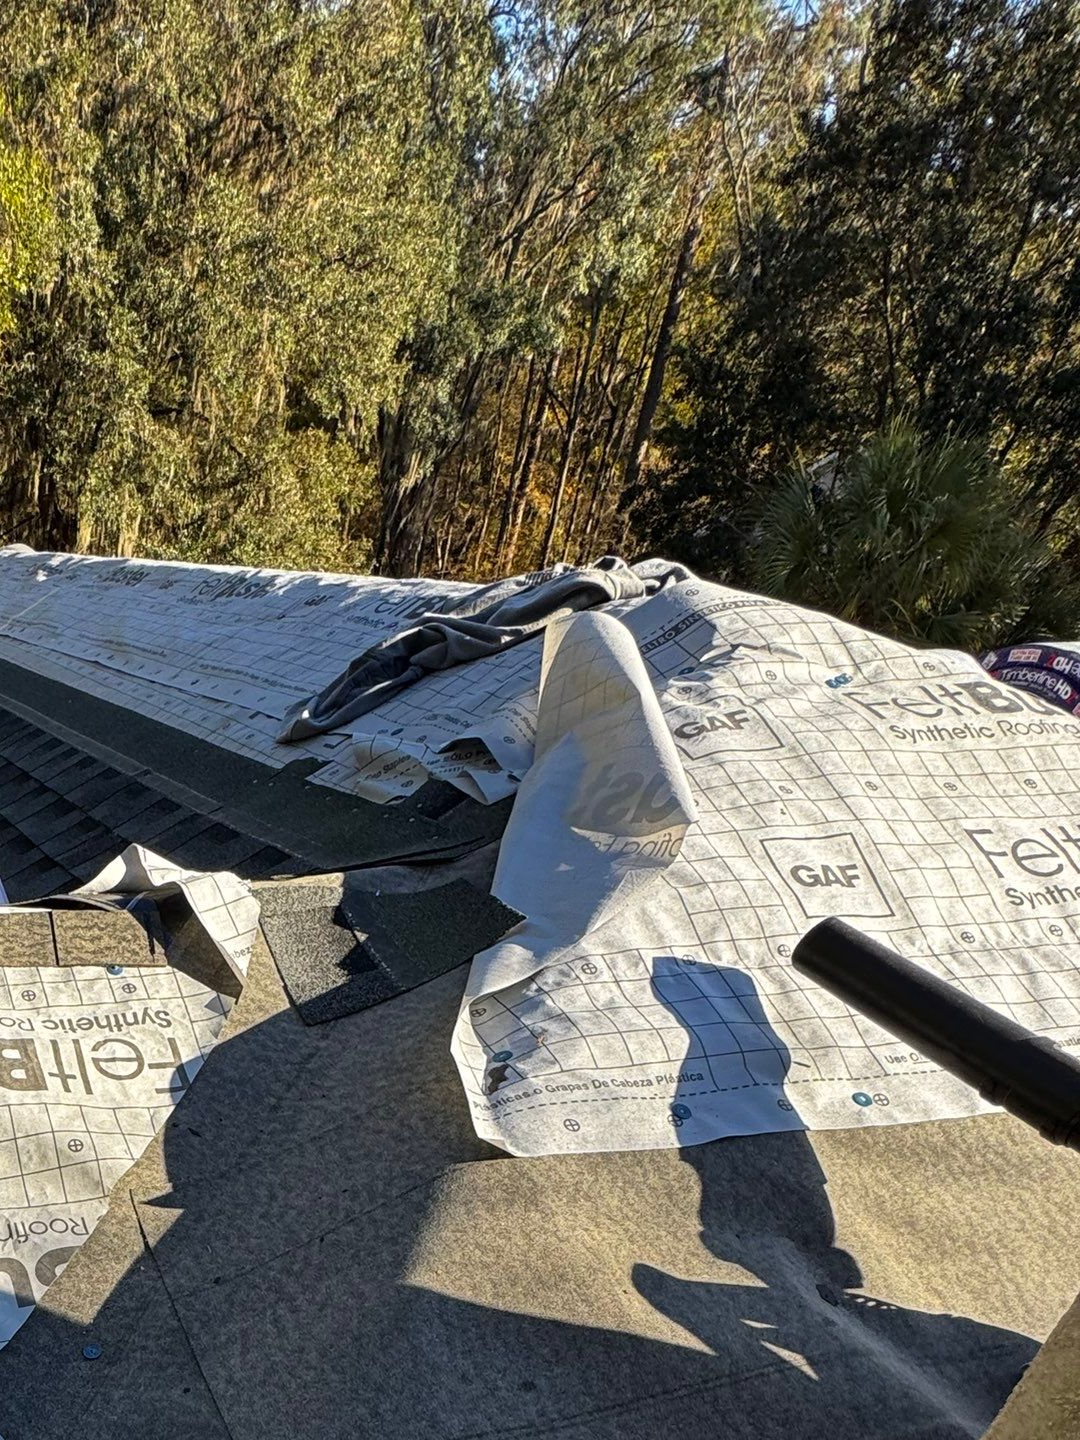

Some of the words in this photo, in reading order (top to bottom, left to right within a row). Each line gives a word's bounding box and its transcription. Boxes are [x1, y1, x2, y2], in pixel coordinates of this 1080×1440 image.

[674, 709, 750, 739] GAF
[888, 722, 995, 744] Synthetic
[789, 863, 861, 889] GAF
[43, 1008, 173, 1036] Synthetic
[544, 1081, 590, 1095] Grapas
[591, 1077, 610, 1090] De
[611, 1076, 653, 1090] Cabeza
[654, 1070, 705, 1086] Plástica
